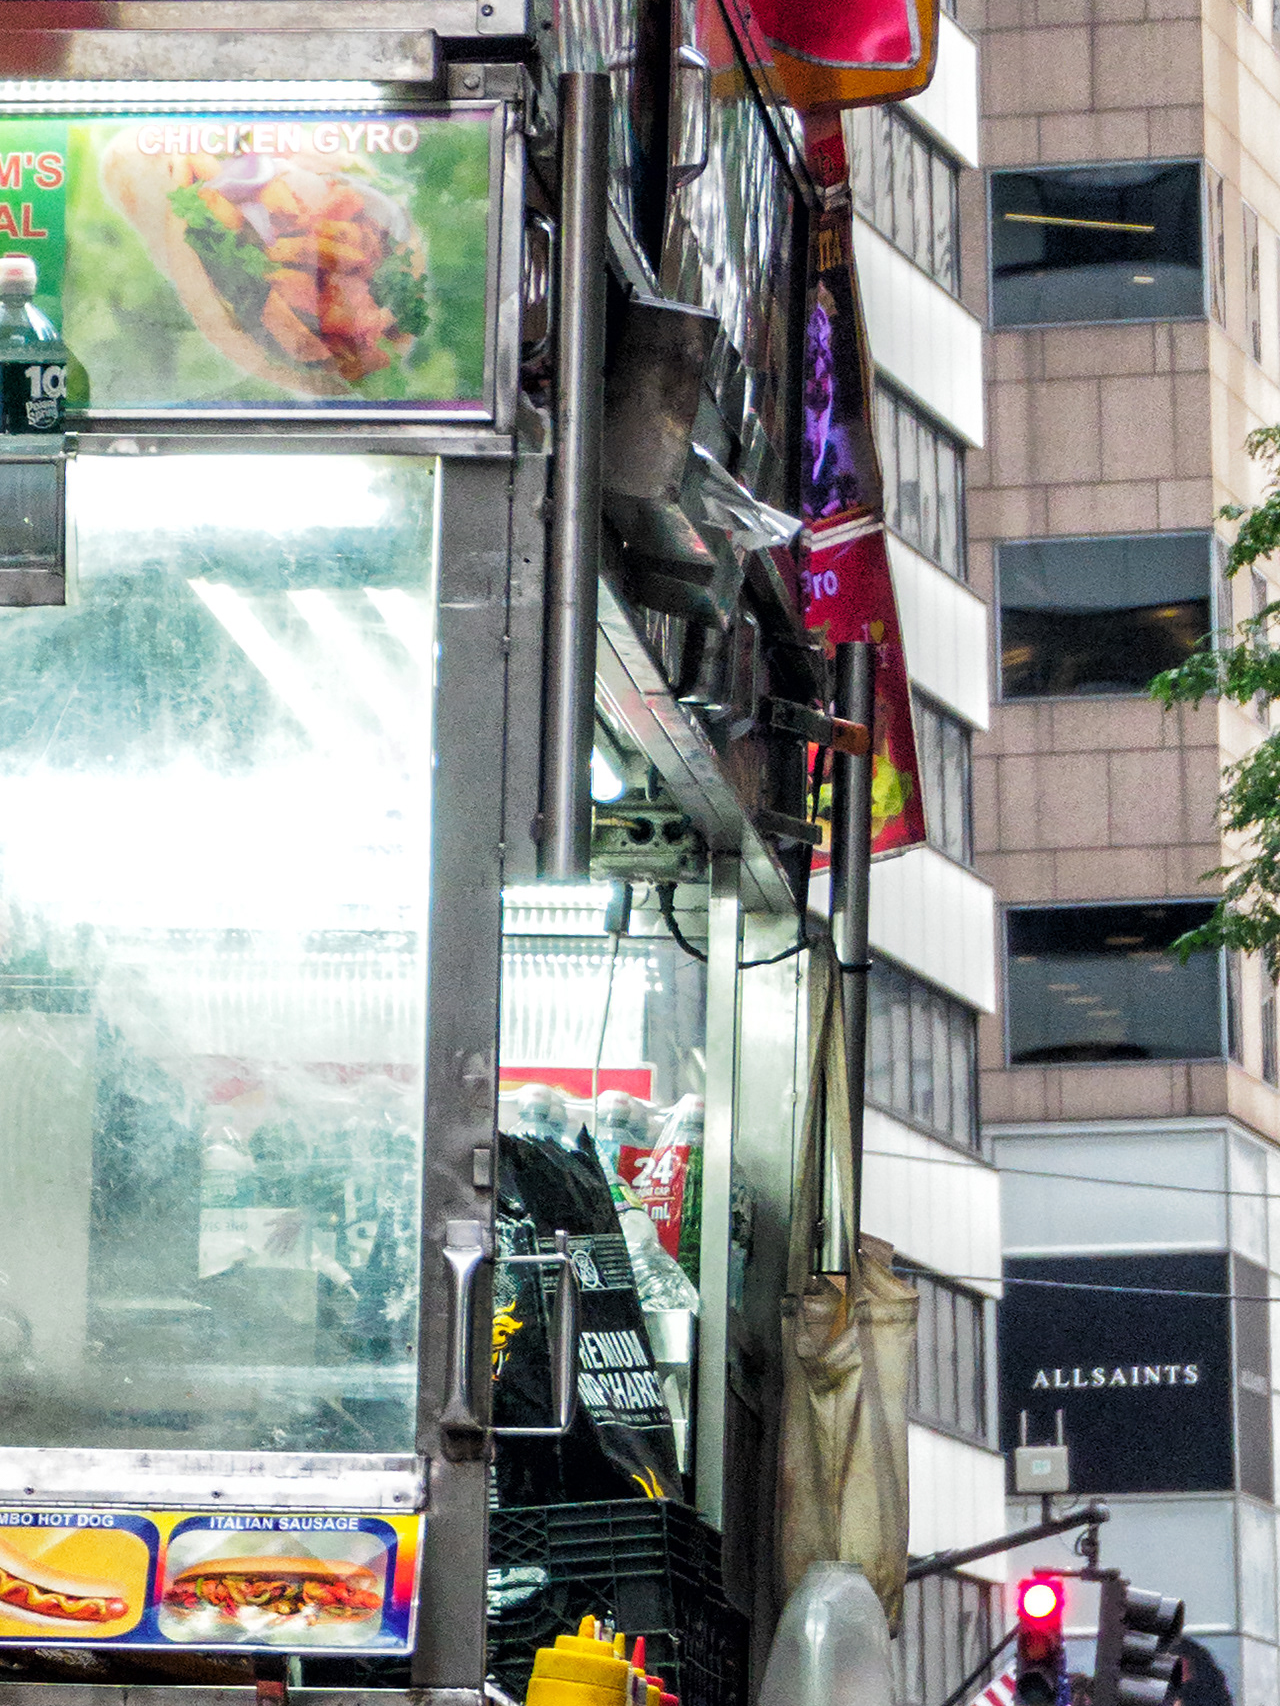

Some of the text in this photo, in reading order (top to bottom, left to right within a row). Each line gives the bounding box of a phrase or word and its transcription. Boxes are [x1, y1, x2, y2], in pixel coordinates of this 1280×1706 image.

[138, 123, 419, 155] CHICKEN GYRO
[633, 1157, 673, 1187] 24
[1032, 1365, 1198, 1390] ALLSAINTS
[38, 1512, 72, 1525] HOT
[77, 1513, 119, 1527] DOG
[209, 1516, 359, 1532] ITALIAN SAUSAGE
